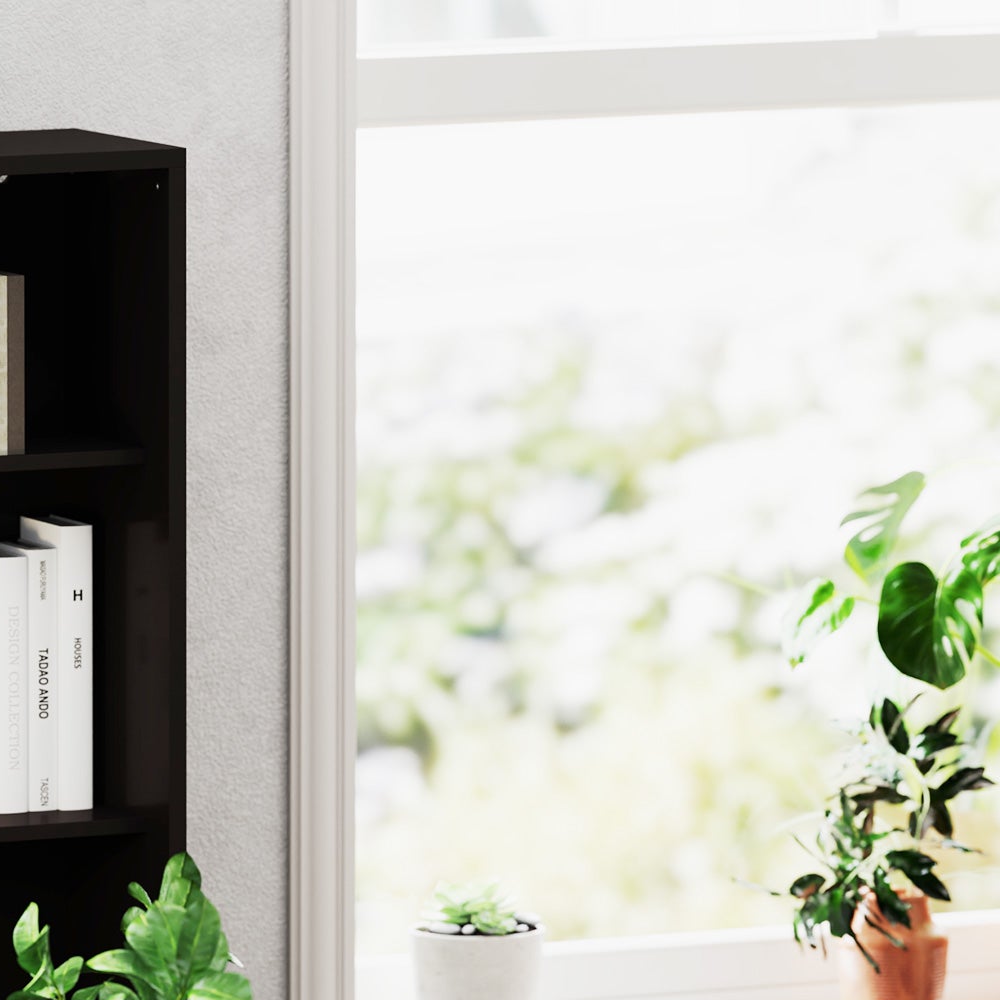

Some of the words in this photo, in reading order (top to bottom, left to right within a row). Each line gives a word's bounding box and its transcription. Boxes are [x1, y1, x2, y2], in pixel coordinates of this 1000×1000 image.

[73, 589, 83, 602] H
[7, 605, 20, 665] DESIGN
[38, 648, 49, 685] TADAO
[74, 637, 82, 669] HOUSES
[9, 671, 20, 770] COLLECTION
[38, 688, 49, 720] ANDO
